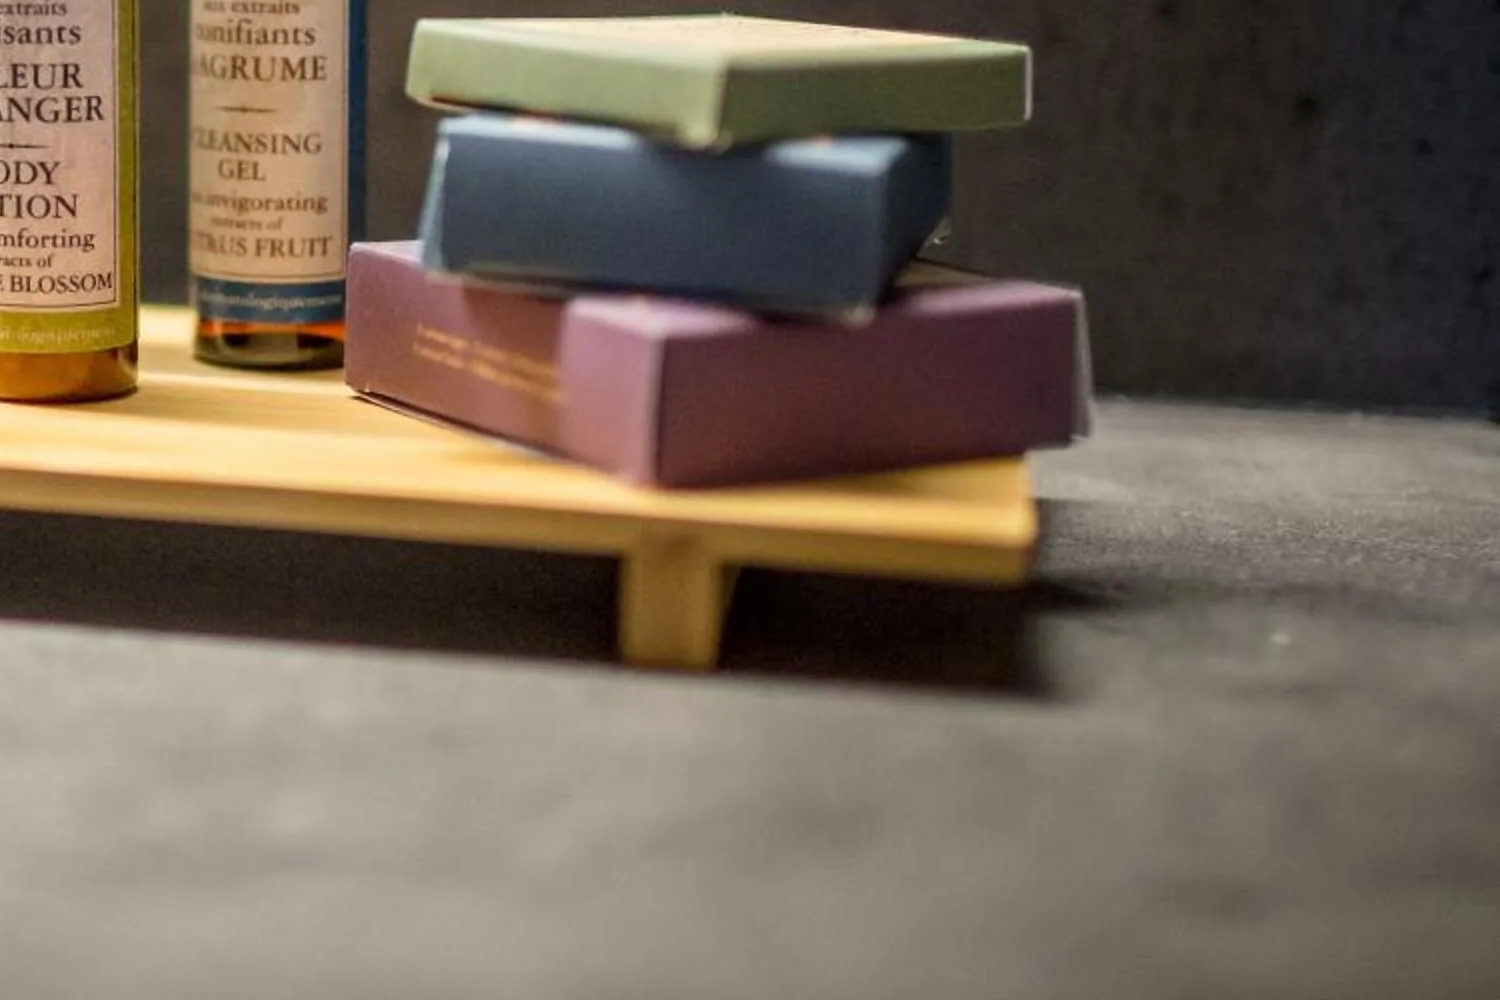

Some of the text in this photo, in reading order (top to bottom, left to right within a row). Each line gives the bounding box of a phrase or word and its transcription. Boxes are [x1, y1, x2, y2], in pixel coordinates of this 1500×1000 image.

[218, 158, 267, 181] GEL
[254, 236, 333, 259] FRUIT
[37, 254, 54, 268] of
[10, 272, 113, 295] BLOSSOM
